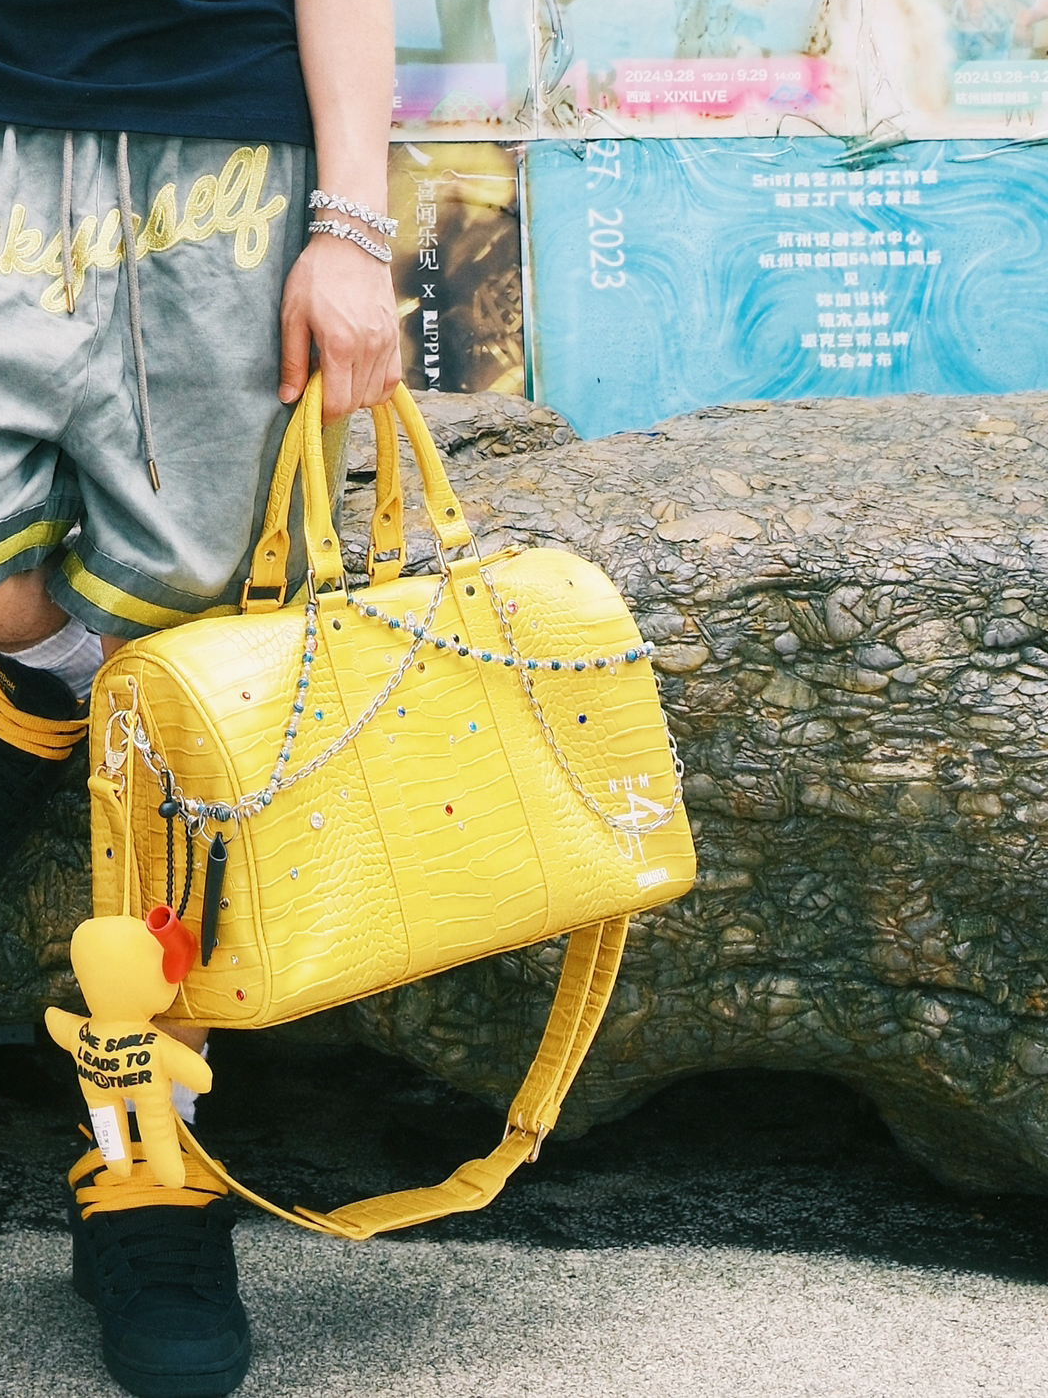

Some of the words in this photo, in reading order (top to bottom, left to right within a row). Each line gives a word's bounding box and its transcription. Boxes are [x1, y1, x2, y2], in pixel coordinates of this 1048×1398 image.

[625, 71, 695, 83] 2024.9.28
[702, 72, 728, 82] 19:30
[737, 69, 767, 81] 9.29
[774, 71, 801, 81] 14:00
[626, 91, 651, 103] 西戏
[663, 90, 727, 103] XIXILIVE
[415, 178, 439, 271] 喜闻乐见
[588, 207, 628, 290] 2023
[636, 867, 670, 888] BOMBER
[78, 1046, 120, 1072] LEADS
[126, 1051, 150, 1068] TO
